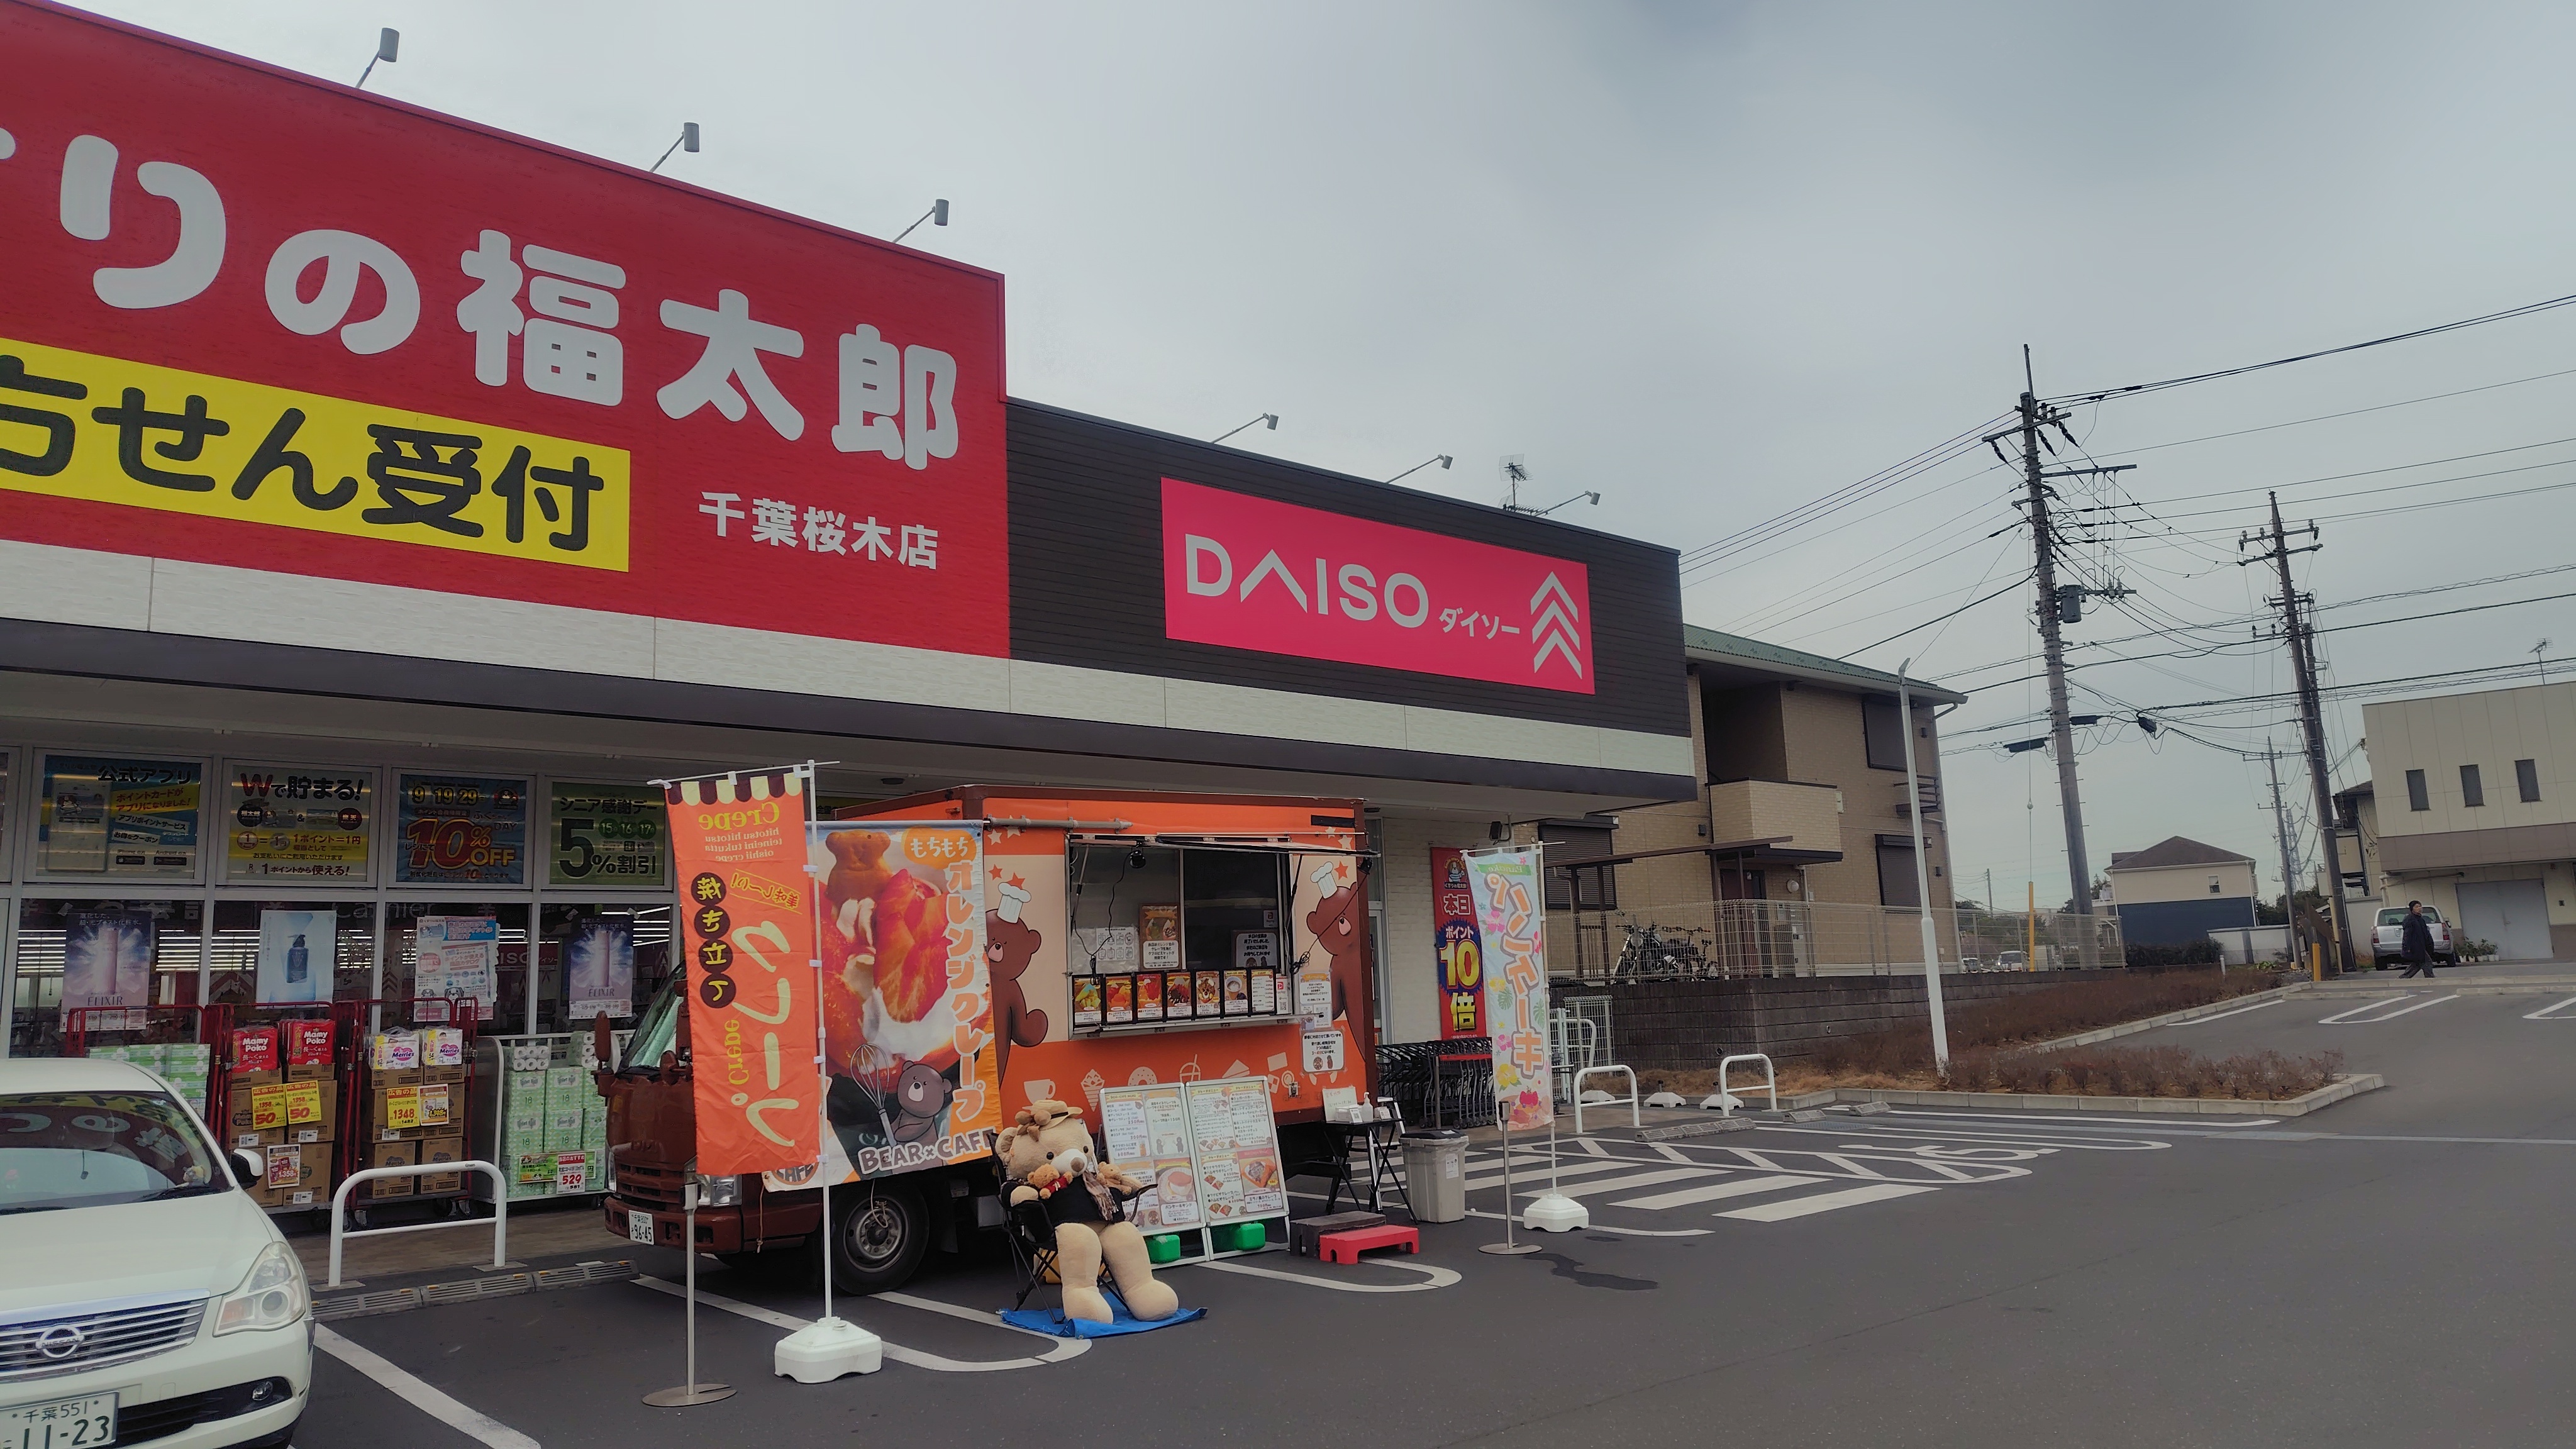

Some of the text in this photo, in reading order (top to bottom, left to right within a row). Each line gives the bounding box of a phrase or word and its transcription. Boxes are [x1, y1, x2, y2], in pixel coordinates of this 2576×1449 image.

[0, 130, 959, 470] りの福太郎
[699, 492, 938, 570] 千葉桜木店
[1185, 533, 1429, 628] DAISO
[1439, 608, 1520, 640] ダイソー
[98, 765, 191, 785] 公式アプリ
[116, 787, 184, 802] ポイントカードが
[240, 773, 364, 801] Wで貯まる!
[560, 797, 657, 815] シニア感謝デー
[118, 814, 187, 830] アプリポイントサービス
[114, 831, 158, 843] お得なクーポン
[911, 836, 969, 858] もちもち
[1443, 893, 1471, 916] 本日
[1446, 926, 1474, 939] ポイント
[500, 952, 528, 964] ISO
[1440, 939, 1481, 989] 10
[589, 988, 615, 997] ELIXIR
[948, 862, 985, 1121] オレンジクレープ
[87, 996, 123, 1006] ELIXIR
[1450, 992, 1476, 1031] 倍
[255, 1112, 276, 1126] 50
[290, 1107, 310, 1119] 50
[394, 1108, 415, 1119] 1348
[562, 1136, 569, 1144] 18
[562, 1174, 582, 1185] 529
[41, 1337, 80, 1348] NISSAN
